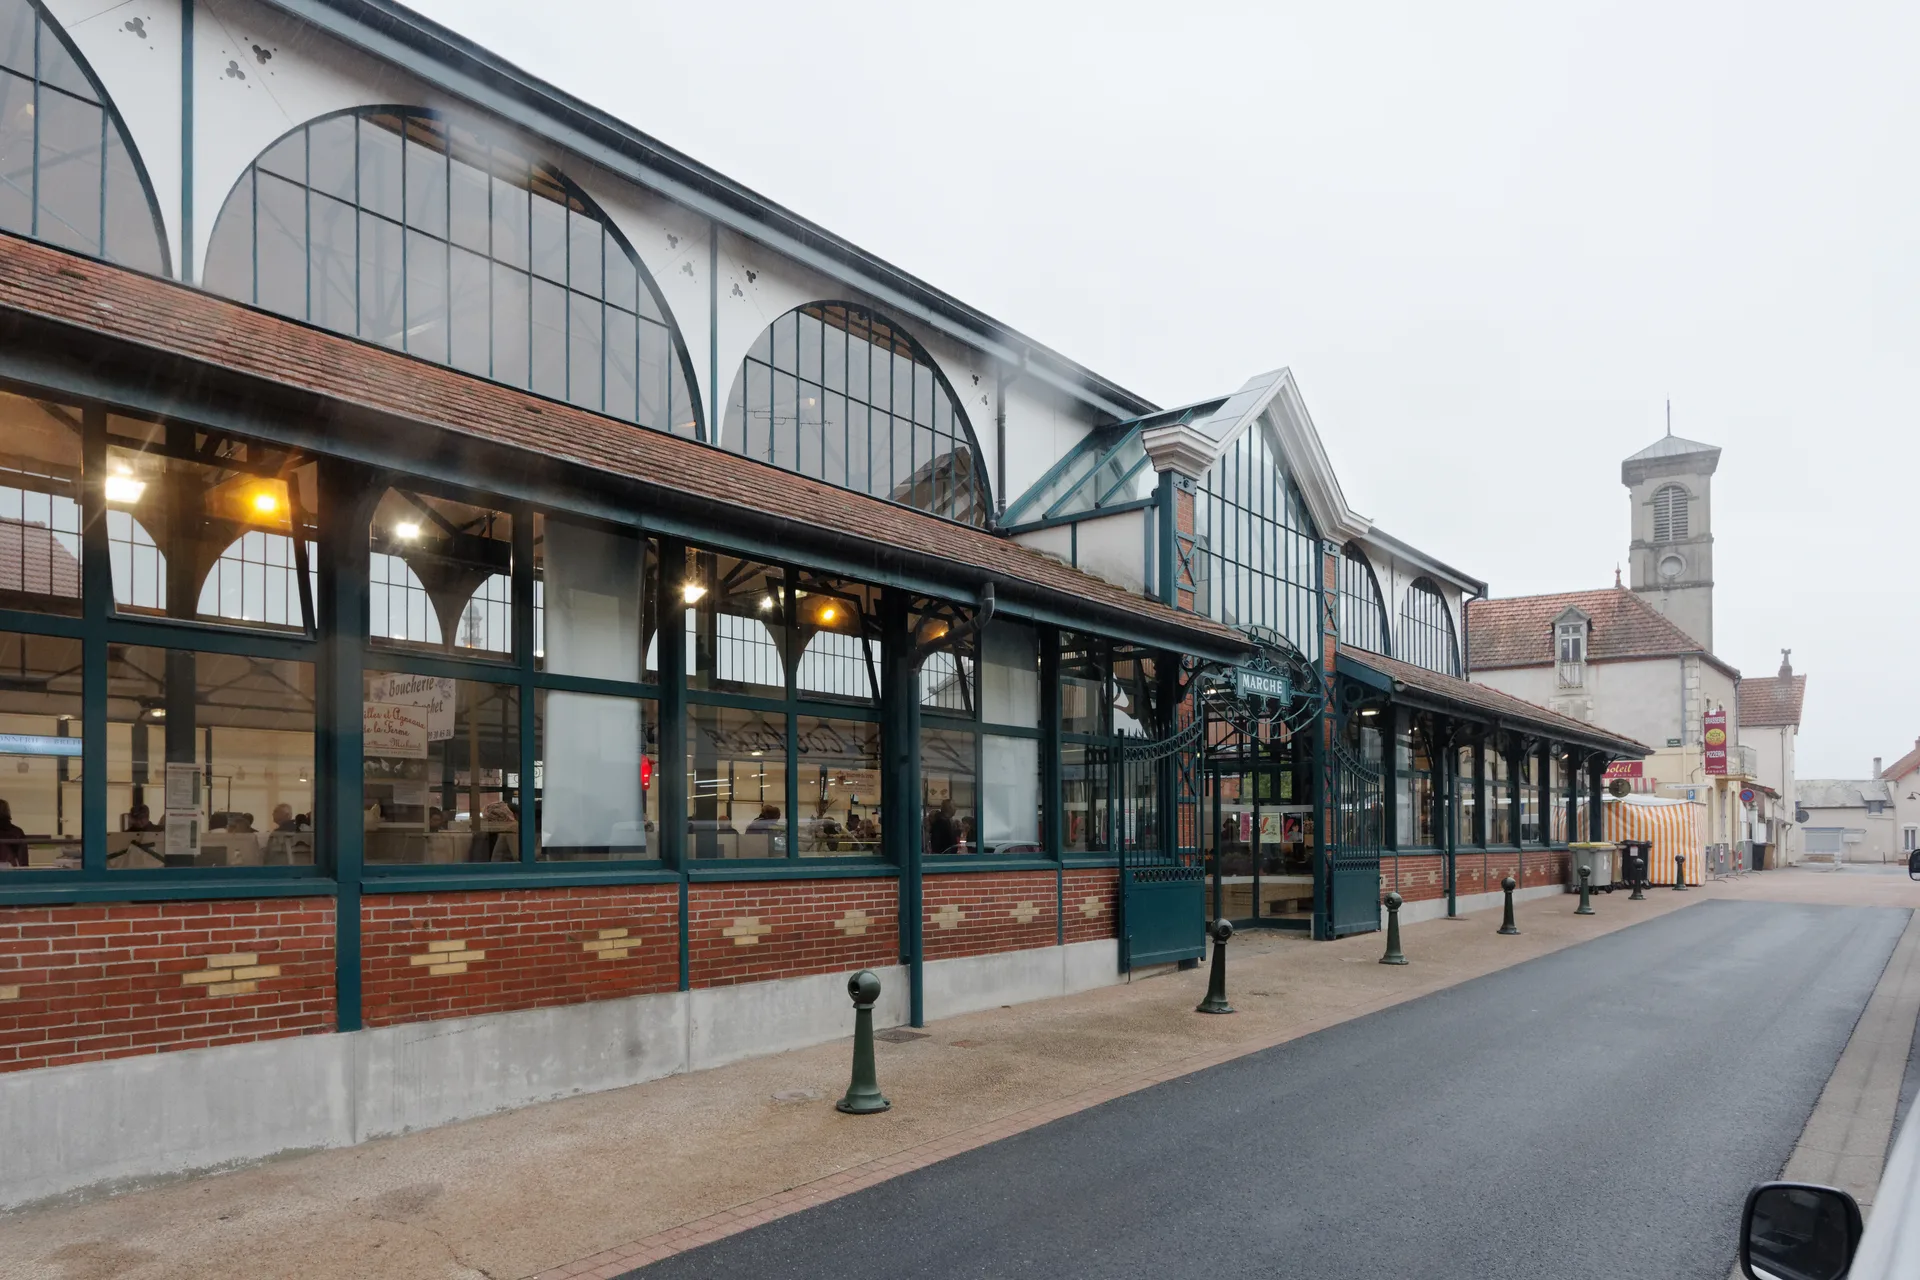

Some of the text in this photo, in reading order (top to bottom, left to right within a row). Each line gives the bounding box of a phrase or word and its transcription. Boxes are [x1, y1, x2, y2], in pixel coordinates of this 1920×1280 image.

[389, 675, 434, 697] Boucherie
[1705, 716, 1725, 724] BRASSERIE
[384, 719, 409, 736] Ferme
[1706, 750, 1725, 758] PIZZERIA
